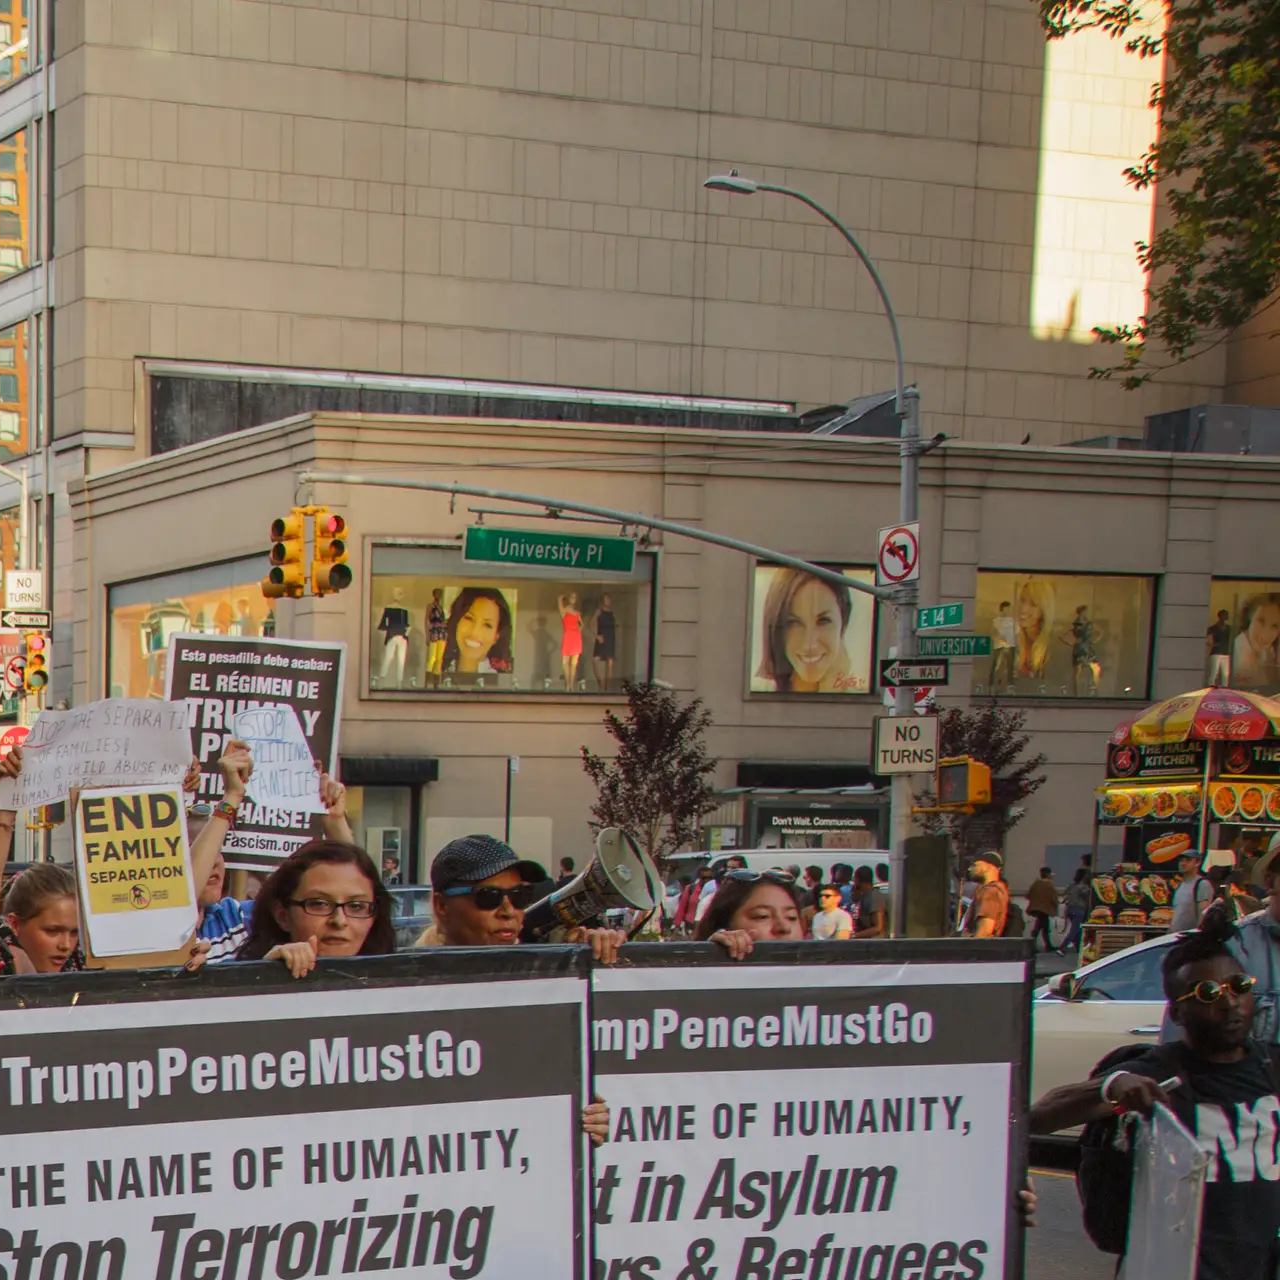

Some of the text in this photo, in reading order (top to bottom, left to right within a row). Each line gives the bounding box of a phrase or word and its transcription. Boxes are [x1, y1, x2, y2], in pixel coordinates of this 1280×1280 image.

[498, 537, 580, 565] University
[16, 578, 32, 588] NO
[9, 592, 40, 603] TURNS
[8, 616, 45, 625] ONE WAY
[920, 610, 928, 627] E
[933, 609, 945, 625] 14
[919, 637, 976, 655] UNIVERSITY
[181, 649, 333, 672] Esta pesadilla debe acabar:
[890, 667, 940, 679] ONE WAY
[190, 670, 320, 700] EL RÉGIMEN DE
[103, 706, 190, 730] SEPARATI
[239, 711, 284, 739] STOP
[304, 710, 323, 737] Y
[895, 725, 920, 742] NO
[251, 742, 309, 764] PLITTING
[881, 749, 934, 764] TURNS
[1145, 755, 1194, 767] KITCHEN
[115, 759, 156, 775] ABUSE
[81, 793, 178, 834] END
[237, 803, 312, 829] HARSE!
[772, 816, 792, 826] Don't
[85, 836, 182, 863] FAMILY
[223, 833, 302, 854] Fascism.or
[90, 865, 184, 884] SEPARATION
[608, 1094, 972, 1143] AME OF HUMANITY,
[86, 1150, 213, 1203] NAME
[232, 1145, 283, 1191] OF
[302, 1128, 531, 1187] HUMANITY,
[630, 1154, 897, 1231] in Asylum
